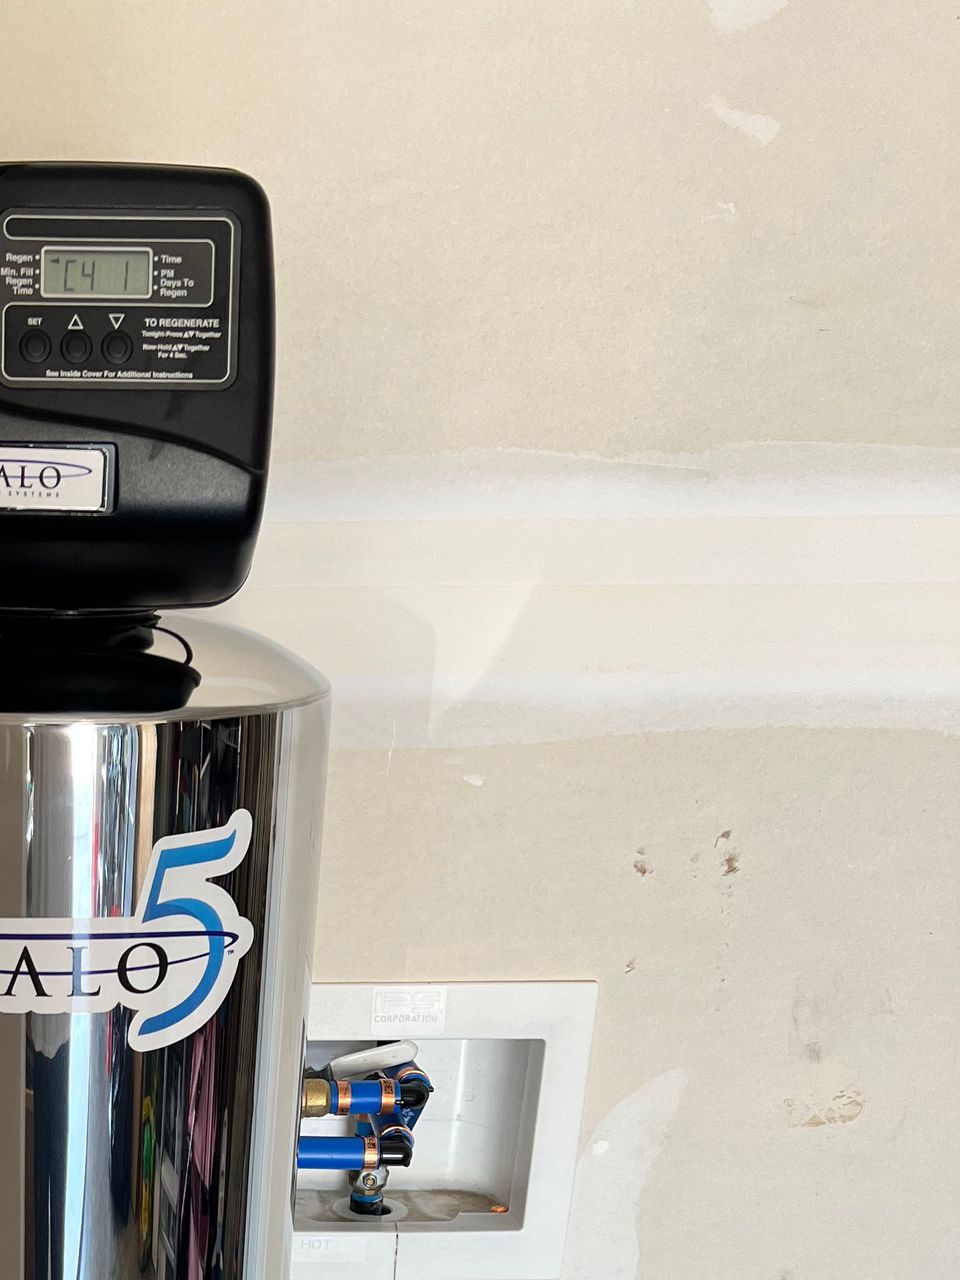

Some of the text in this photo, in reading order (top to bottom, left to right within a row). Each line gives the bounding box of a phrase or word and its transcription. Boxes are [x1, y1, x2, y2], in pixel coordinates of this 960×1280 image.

[5, 252, 33, 264] Regen
[160, 254, 182, 264] Time
[0, 267, 34, 276] Min. Fill
[160, 269, 175, 278] PM
[5, 276, 33, 287] Regen
[160, 277, 195, 288] Days To
[12, 286, 34, 295] Time
[160, 288, 188, 299] Regen
[144, 318, 220, 328] TO REGENERATE
[82, 370, 103, 378] Cover
[103, 370, 116, 378] For
[116, 370, 152, 378] Additional
[152, 371, 193, 379] Instructions
[8, 490, 60, 499] SYSTEMS
[137, 829, 237, 1037] 5
[374, 1014, 439, 1023] CORPORATION
[301, 1238, 332, 1250] HOT
